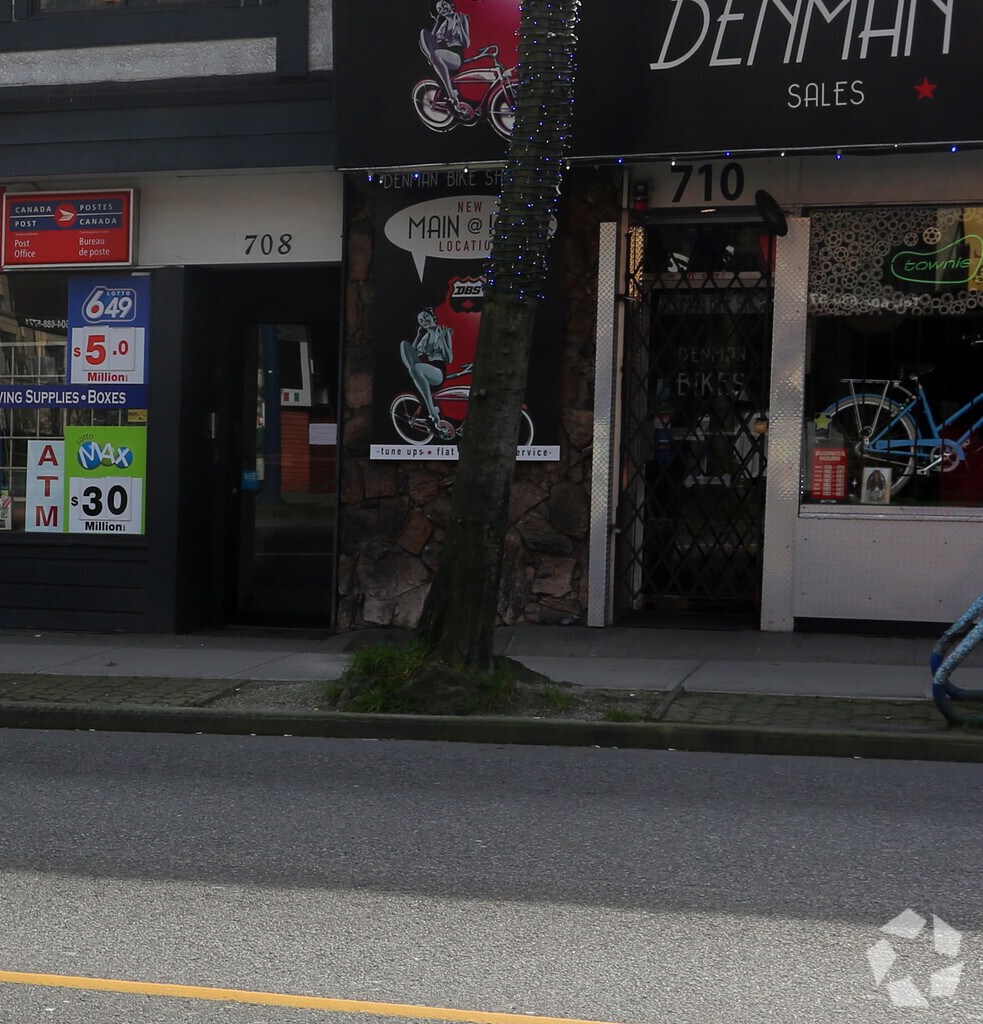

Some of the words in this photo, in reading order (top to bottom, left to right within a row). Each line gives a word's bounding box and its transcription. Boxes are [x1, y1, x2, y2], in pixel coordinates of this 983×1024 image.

[787, 80, 865, 109] SALES
[447, 171, 476, 186] BIKE
[485, 170, 503, 186] SH
[670, 162, 745, 203] 710
[80, 203, 113, 211] POSTES
[458, 201, 482, 212] NEW
[408, 215, 459, 239] MAIN
[467, 217, 483, 234] @
[79, 237, 105, 245] Bureau
[244, 233, 292, 255] 708
[439, 240, 491, 252] LOCATIO
[14, 249, 36, 257] Office
[79, 248, 88, 256] de
[89, 248, 110, 257] poste
[904, 257, 972, 271] townie
[454, 285, 482, 295] DBS
[87, 372, 124, 382] Million
[25, 389, 79, 404] SUPPLIES
[88, 390, 126, 405] BOXES
[436, 448, 455, 456] flat
[85, 522, 122, 531] Million
